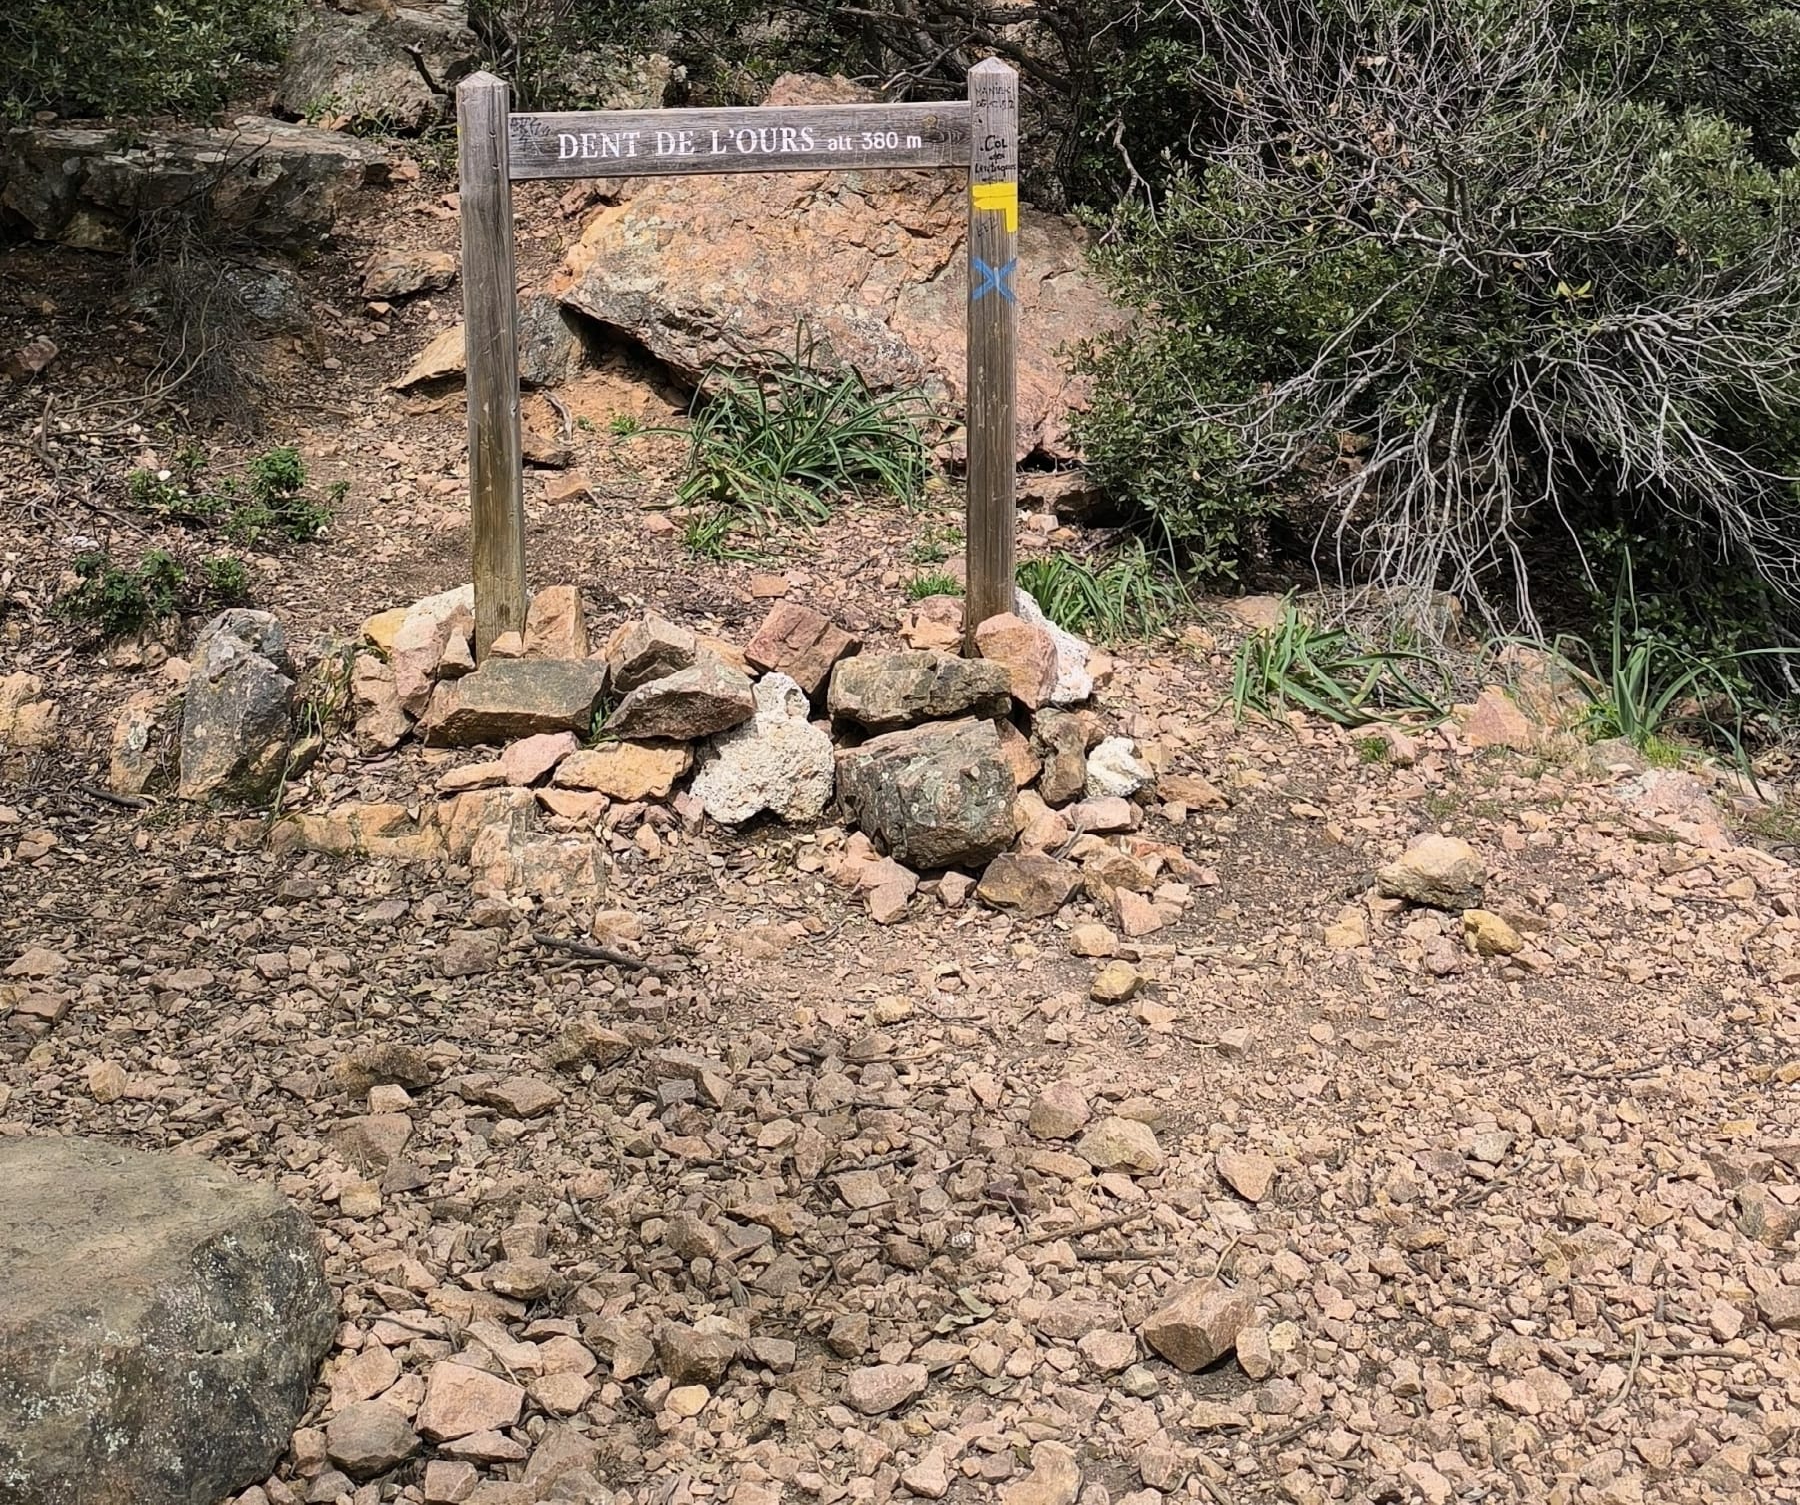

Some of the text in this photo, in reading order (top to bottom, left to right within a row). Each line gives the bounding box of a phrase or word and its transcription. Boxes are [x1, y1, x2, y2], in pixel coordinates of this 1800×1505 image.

[558, 131, 641, 159] DENT
[655, 129, 695, 156] DE
[710, 127, 814, 155] L'OURS
[827, 136, 853, 151] alt
[861, 132, 898, 149] 380
[906, 134, 922, 149] m
